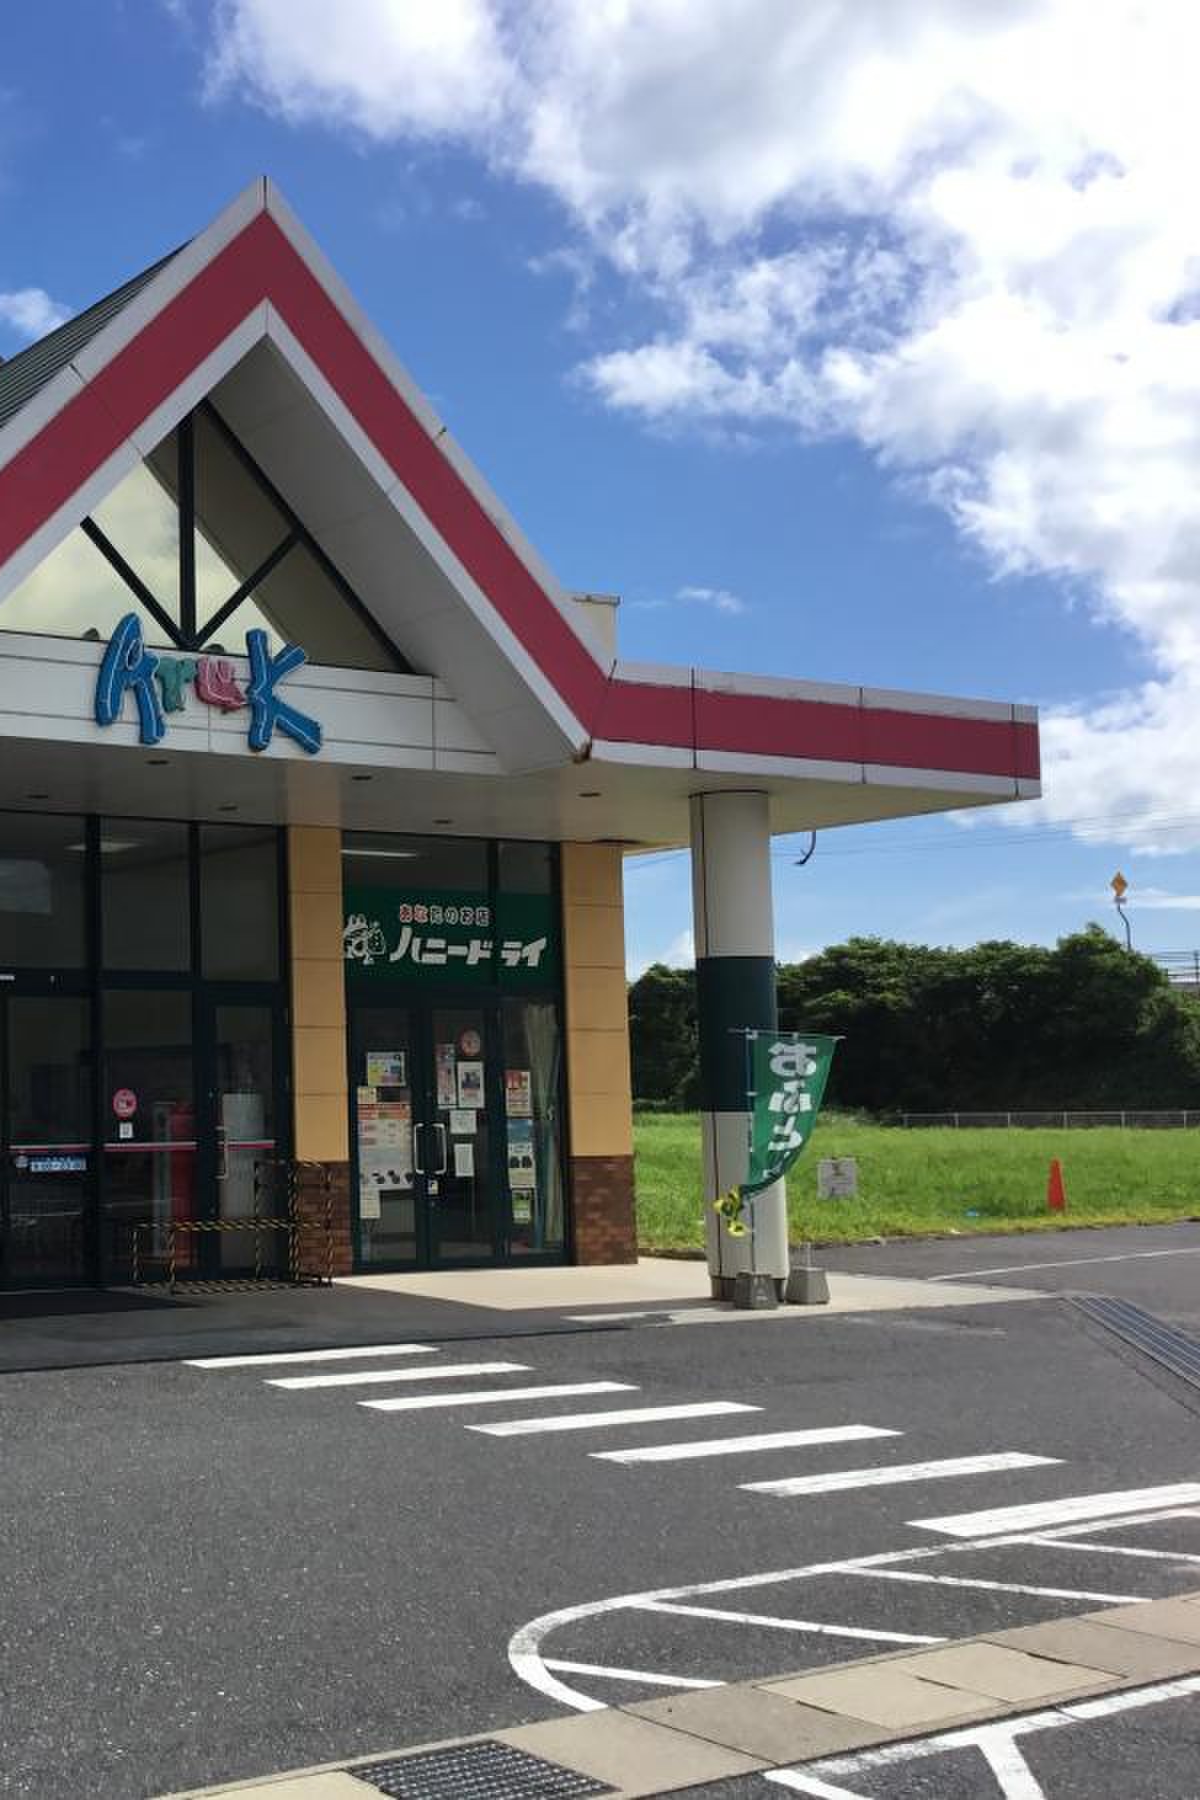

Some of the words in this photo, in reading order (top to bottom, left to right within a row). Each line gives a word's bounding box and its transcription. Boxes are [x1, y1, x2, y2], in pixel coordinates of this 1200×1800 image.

[389, 927, 547, 967] ハニードライ
